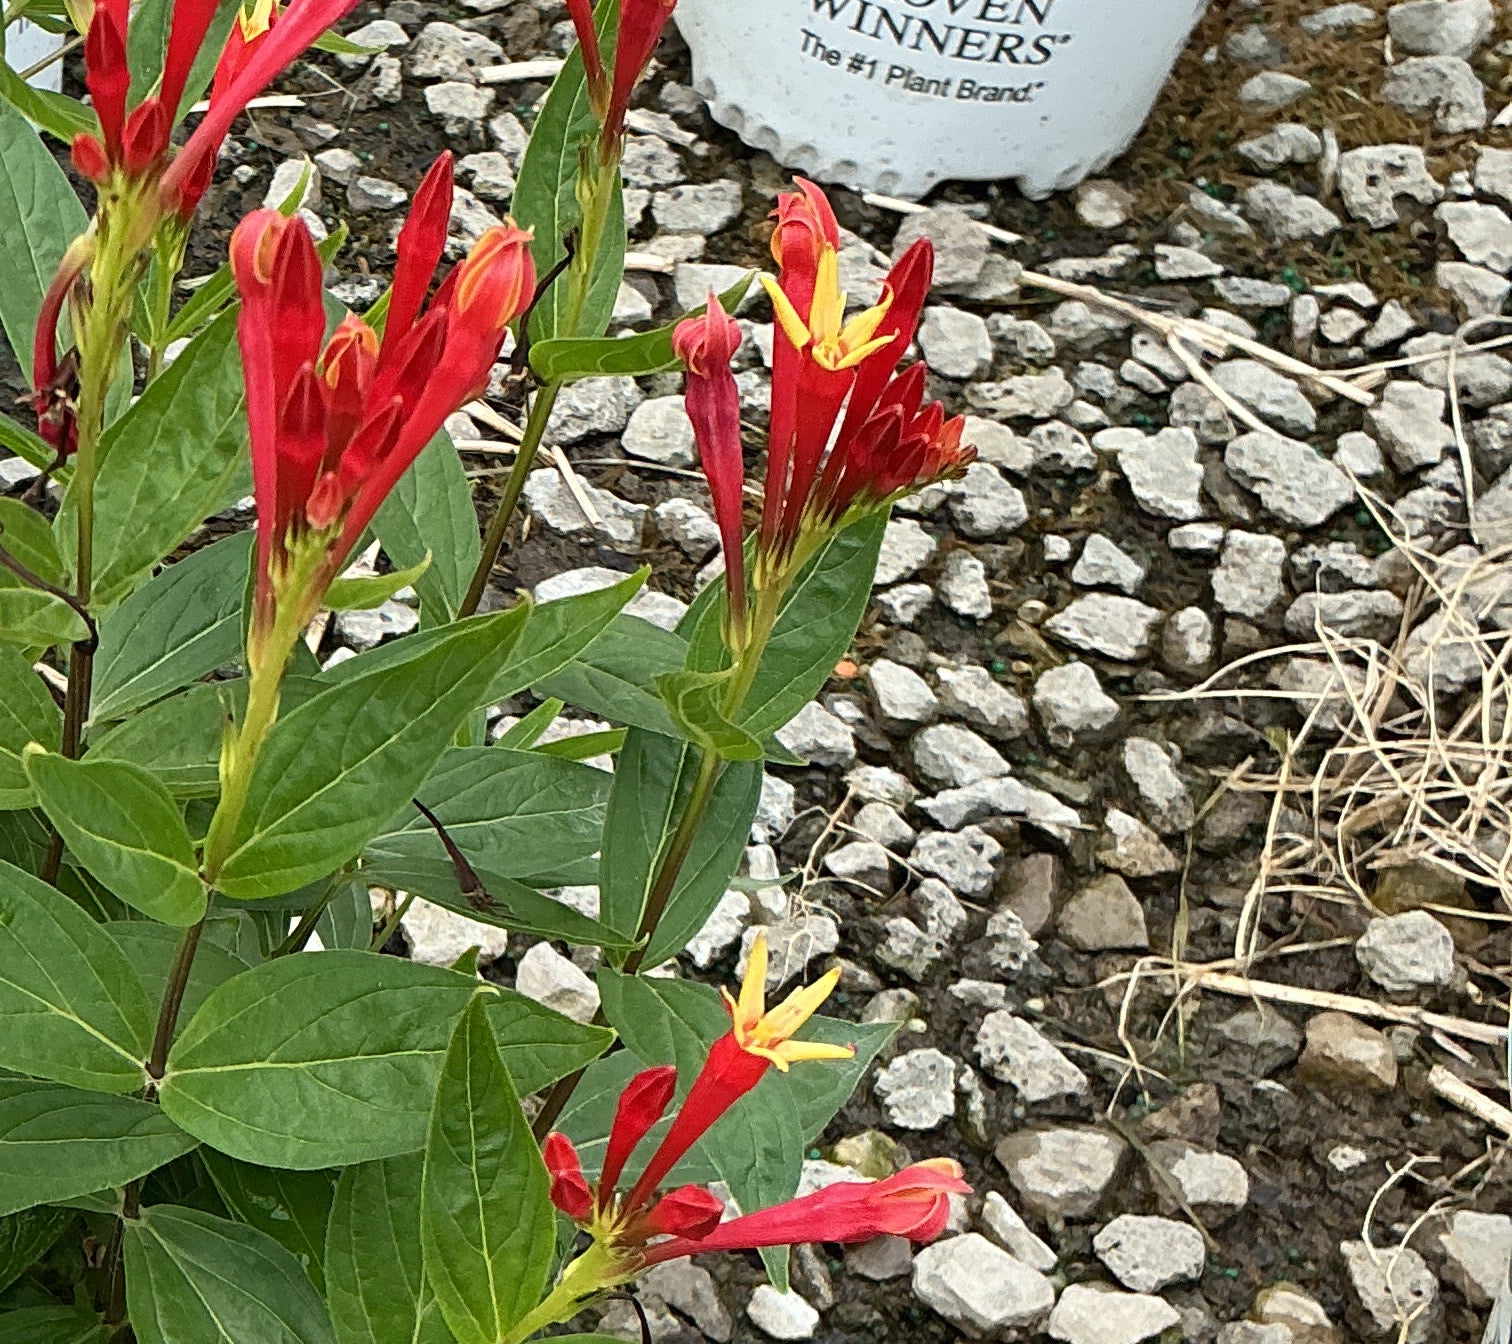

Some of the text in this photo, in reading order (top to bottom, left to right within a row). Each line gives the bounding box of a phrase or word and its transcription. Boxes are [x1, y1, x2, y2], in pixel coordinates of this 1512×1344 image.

[800, 27, 841, 67] The
[847, 51, 879, 82] #1
[885, 64, 952, 100] Plant
